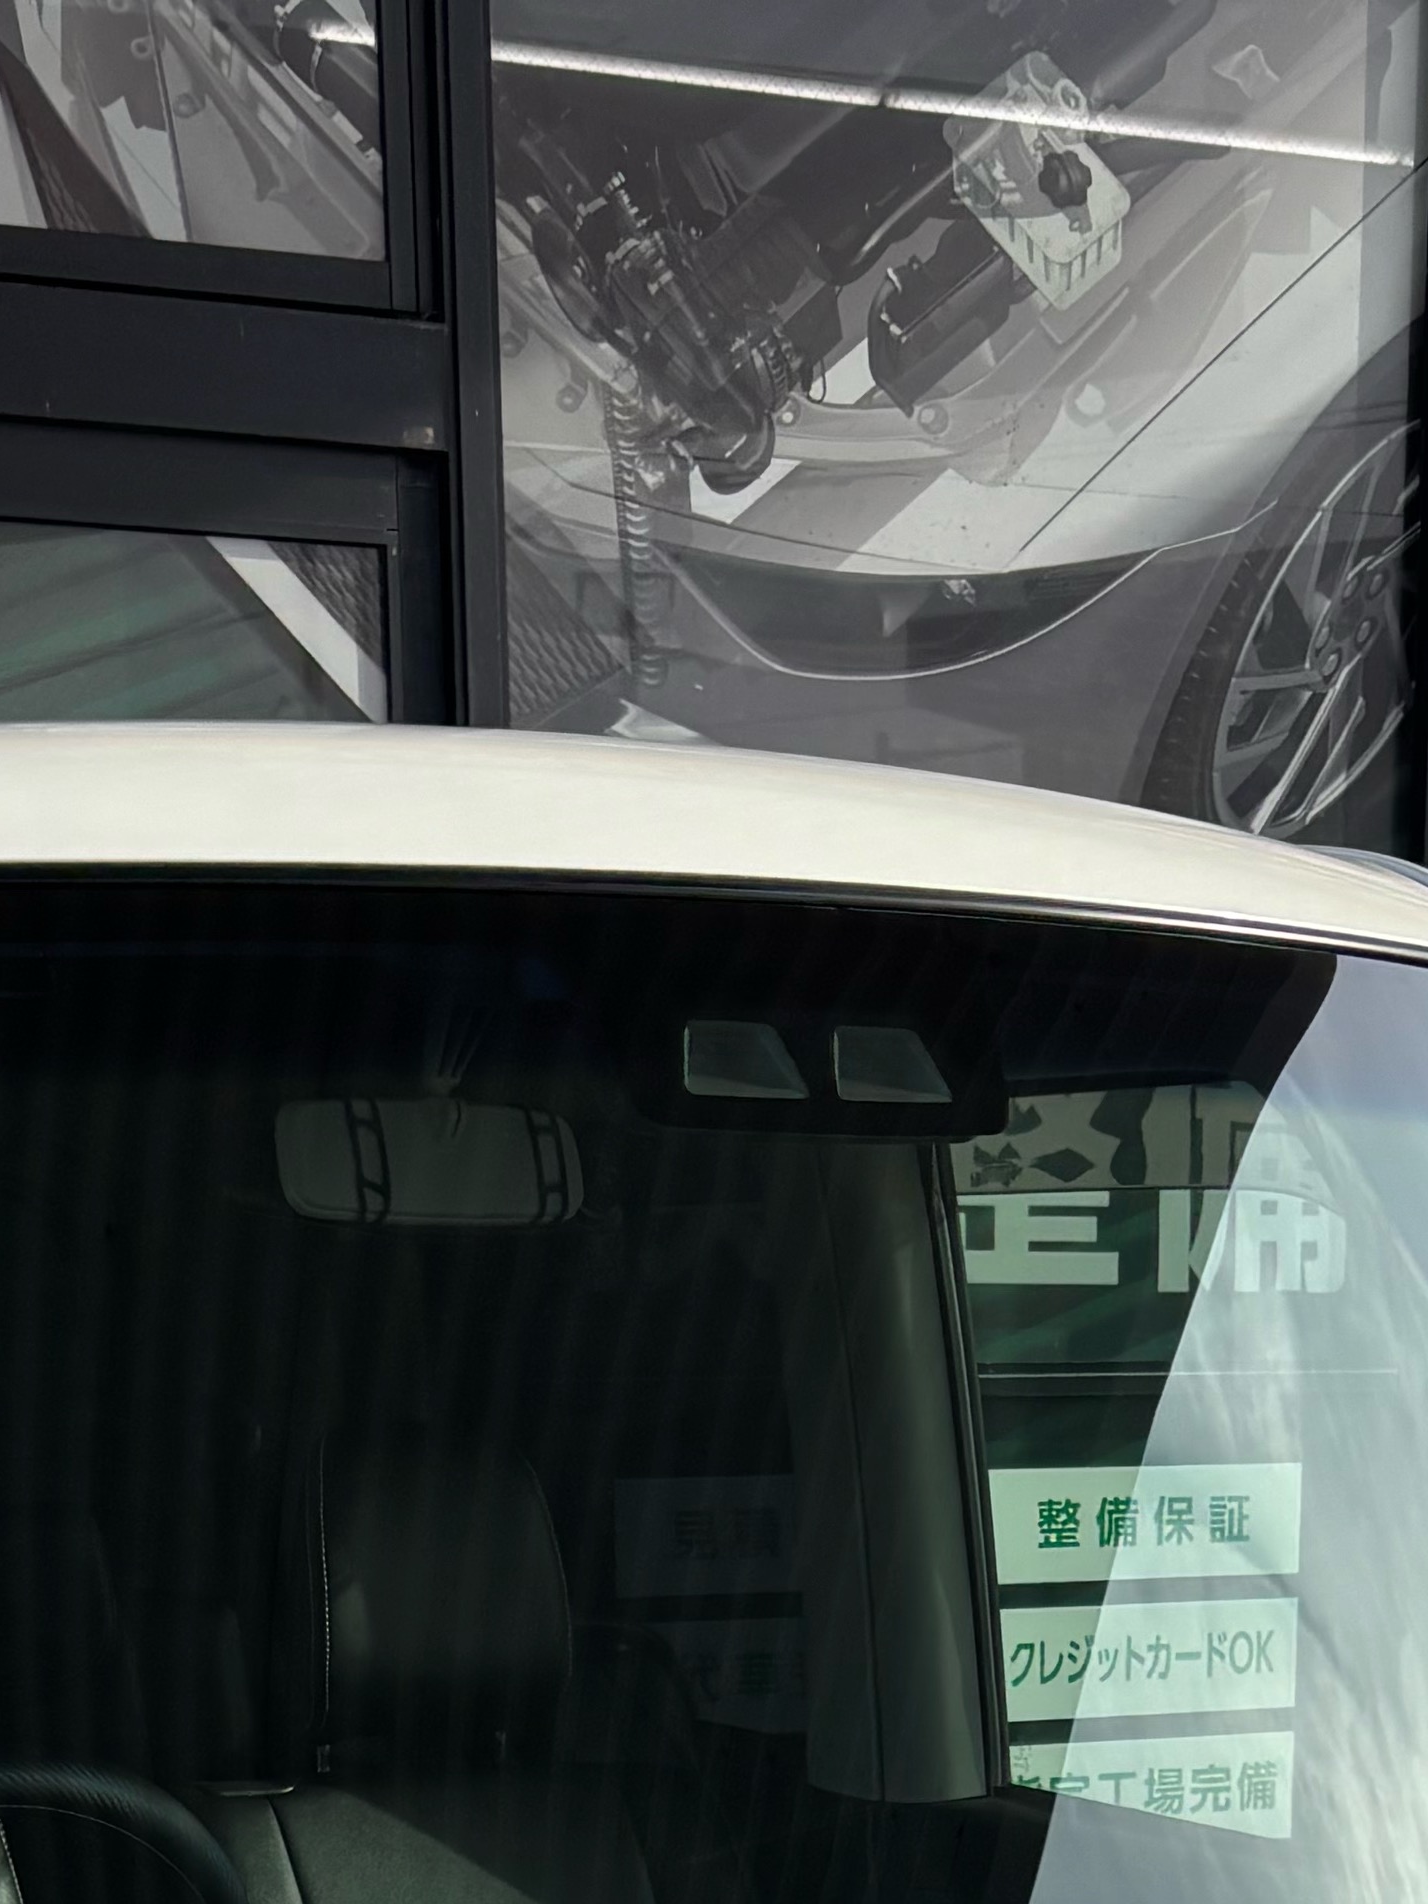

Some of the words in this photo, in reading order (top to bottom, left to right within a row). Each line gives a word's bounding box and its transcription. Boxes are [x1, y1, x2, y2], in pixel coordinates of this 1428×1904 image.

[1036, 1495, 1252, 1549] 整備保証
[1010, 1629, 1276, 1687] クレジットカードOK
[1012, 1759, 1278, 1815] 工場完備
